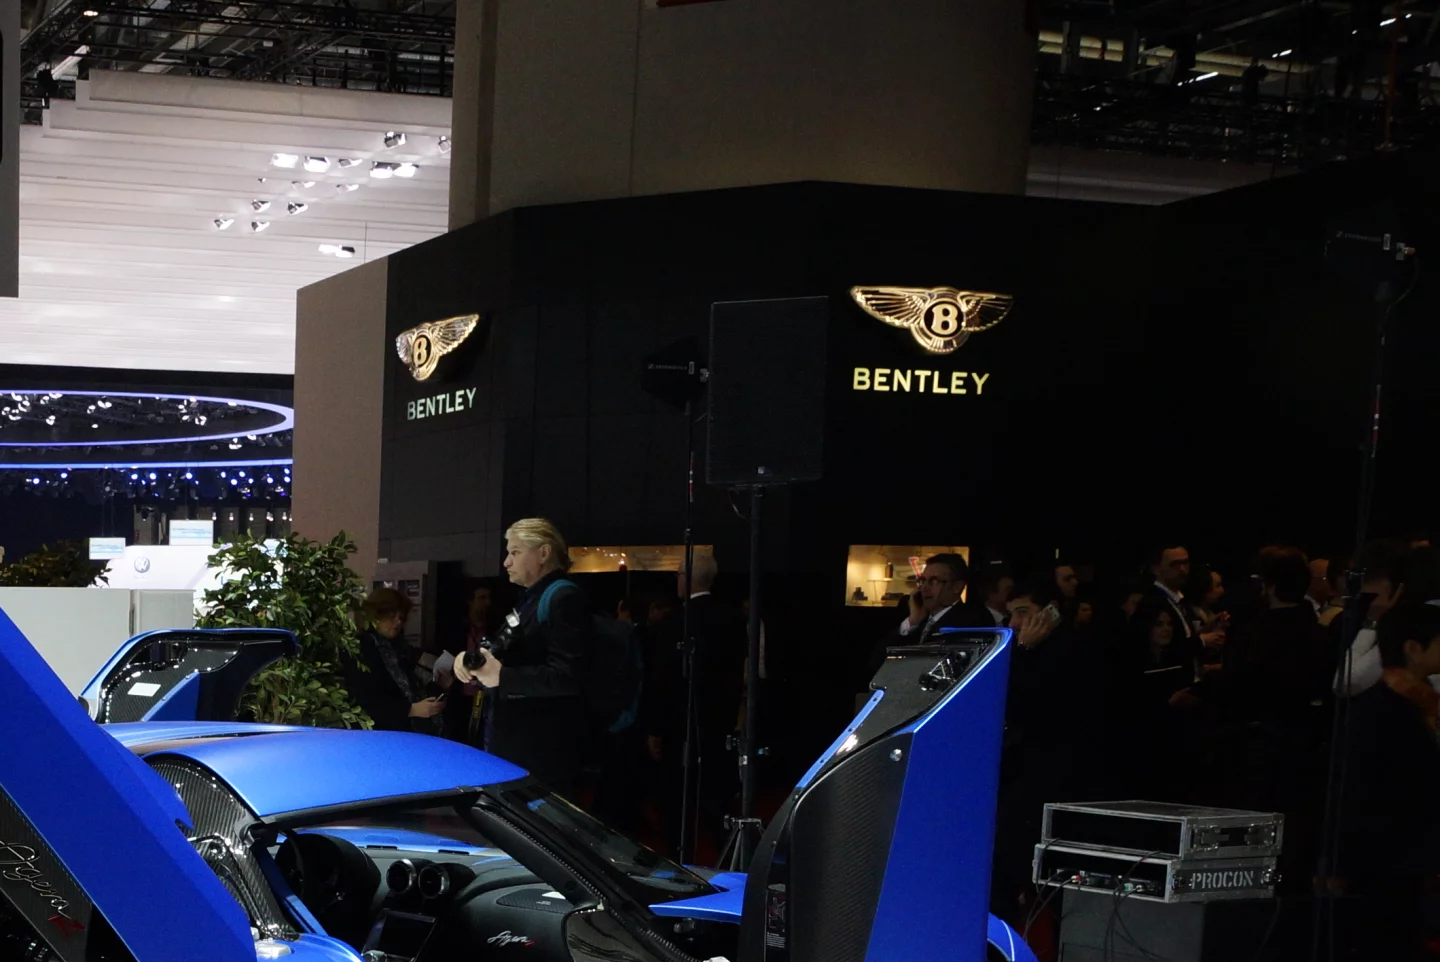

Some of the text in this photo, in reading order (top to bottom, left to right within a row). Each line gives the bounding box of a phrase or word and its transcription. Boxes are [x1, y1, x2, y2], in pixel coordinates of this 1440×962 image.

[853, 367, 990, 395] BENTLEY
[406, 387, 477, 421] BENTLEY
[1190, 870, 1255, 890] PROCON
